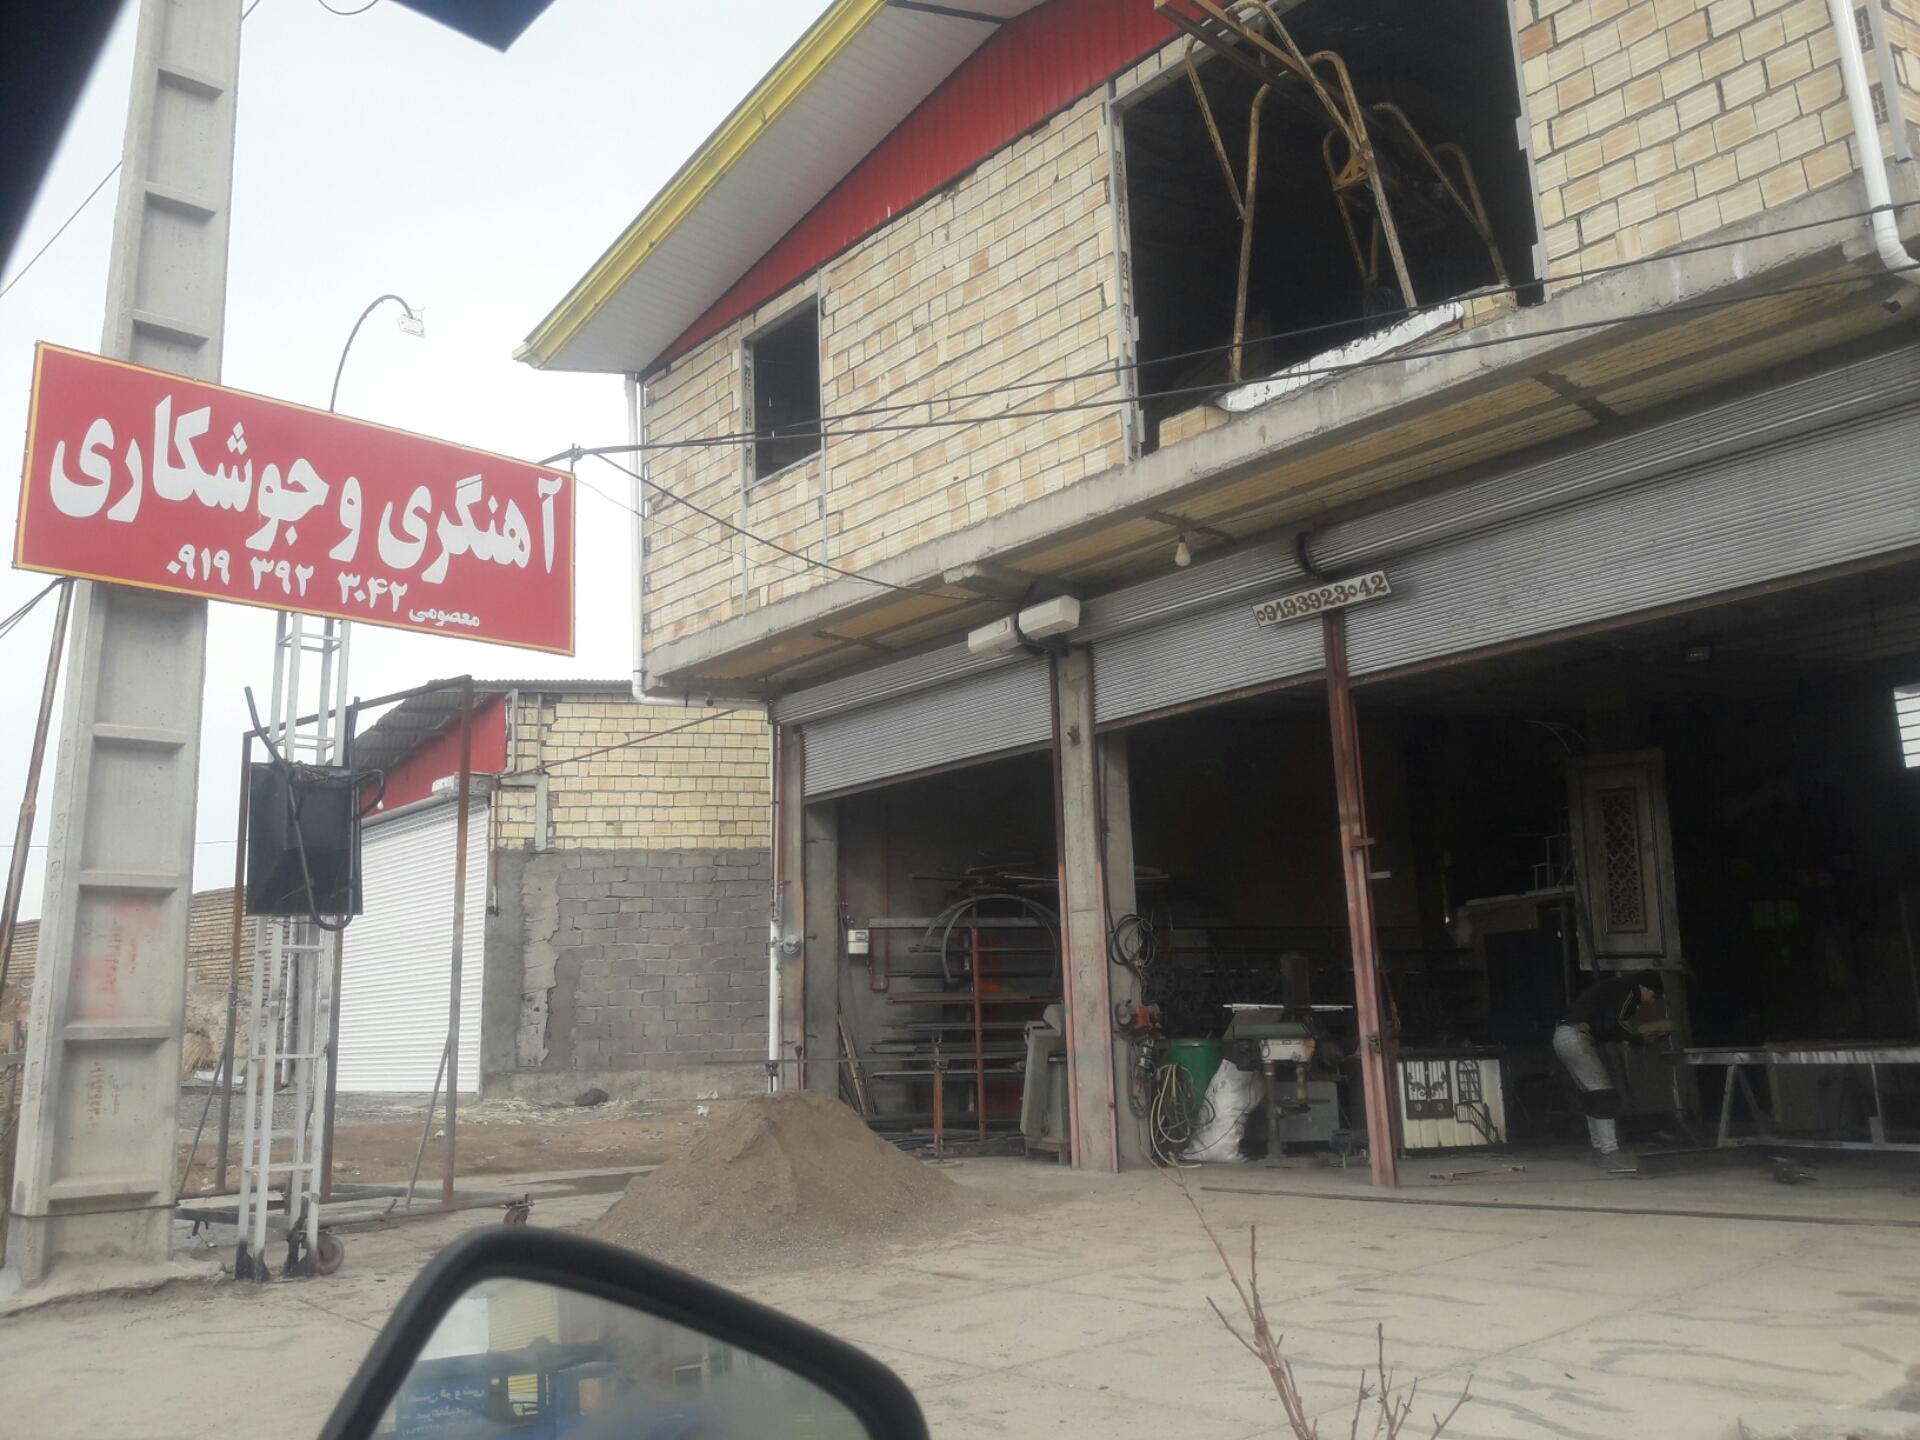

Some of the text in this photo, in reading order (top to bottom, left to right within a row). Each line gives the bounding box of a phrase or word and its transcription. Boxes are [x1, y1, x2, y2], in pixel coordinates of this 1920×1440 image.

[49, 394, 563, 584] آهنگری و جوشکاری
[166, 544, 408, 613] ۰۹۱۹ ۳۹۲ ۳۰۴۲
[408, 607, 480, 627] معصومی
